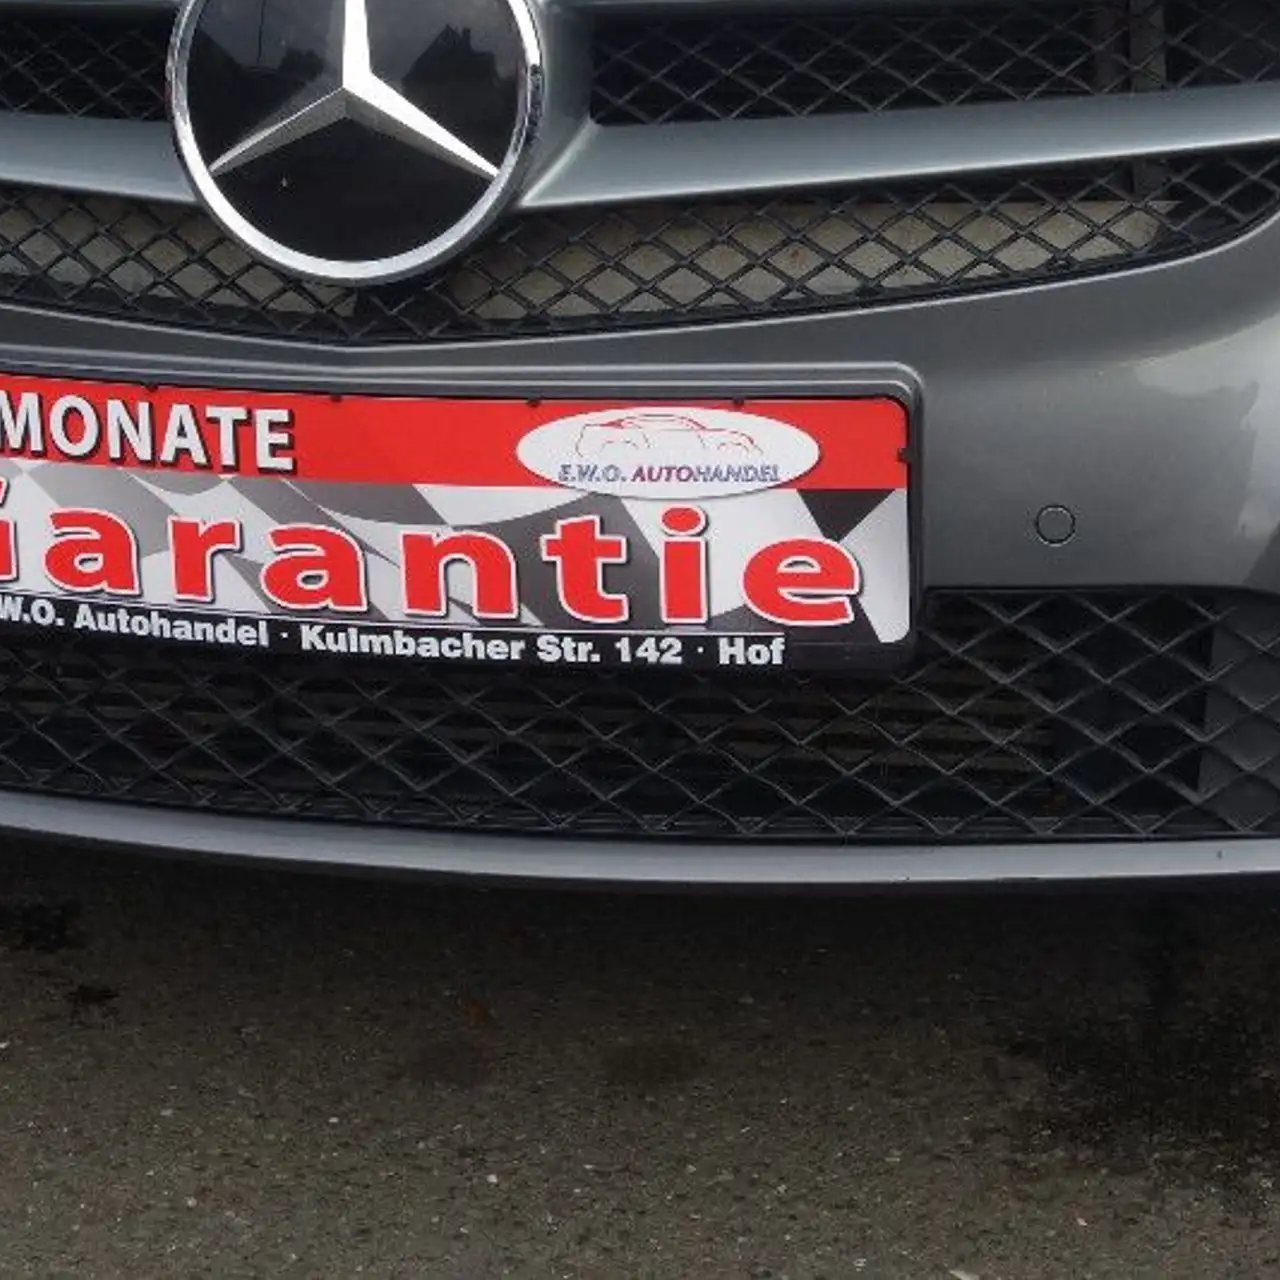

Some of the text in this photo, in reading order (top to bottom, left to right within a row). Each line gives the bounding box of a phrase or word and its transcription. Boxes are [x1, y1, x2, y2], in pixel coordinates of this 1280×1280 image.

[557, 463, 780, 483] E.W.O. AUTOHANDEL
[73, 603, 270, 648] Autohandel
[299, 624, 525, 661] Kulmbacher
[536, 633, 601, 663] Str.
[617, 636, 683, 665] 142
[719, 635, 786, 665] Hof
